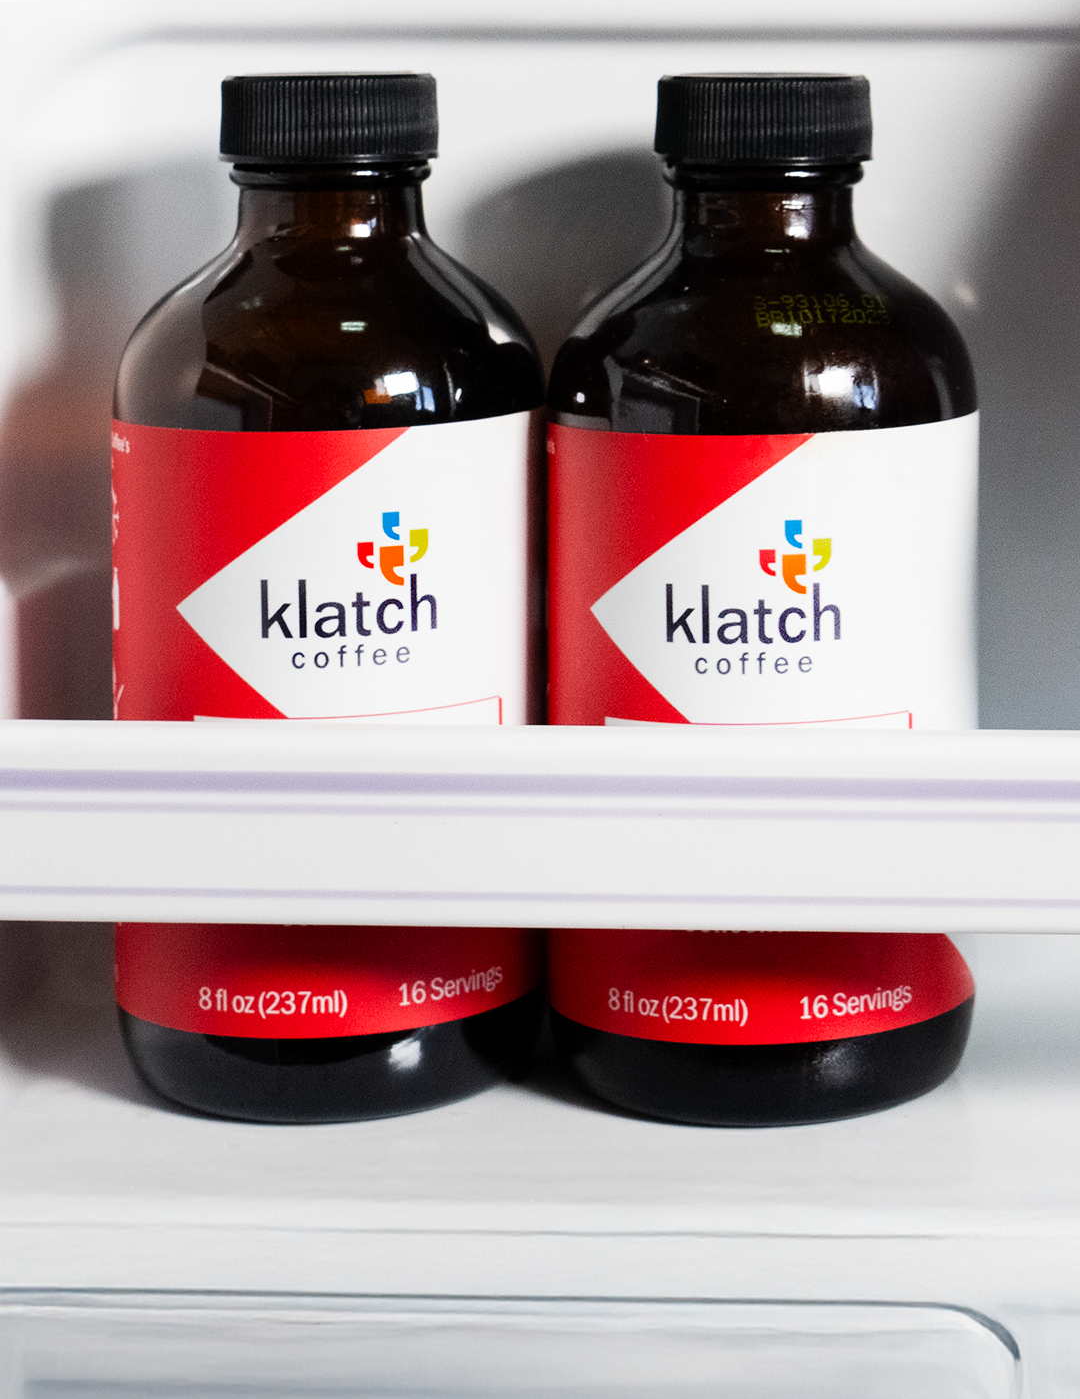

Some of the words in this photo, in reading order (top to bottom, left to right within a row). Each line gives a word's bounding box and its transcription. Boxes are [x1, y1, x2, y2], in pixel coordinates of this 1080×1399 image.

[260, 574, 437, 639] klatch
[665, 582, 841, 645] klatch
[291, 643, 410, 669] coffee
[694, 651, 813, 675] coffee
[198, 986, 212, 1011] 8
[215, 988, 228, 1012] fl
[231, 995, 255, 1014] oz
[258, 989, 348, 1019] (237ml)
[398, 980, 427, 1007] 16
[430, 965, 503, 1001] Servings
[800, 994, 829, 1020] 16
[832, 984, 913, 1017] Servings
[608, 986, 621, 1011] 8
[623, 989, 634, 1013] fl
[638, 998, 660, 1017] oz
[662, 995, 749, 1027] (237ml)
